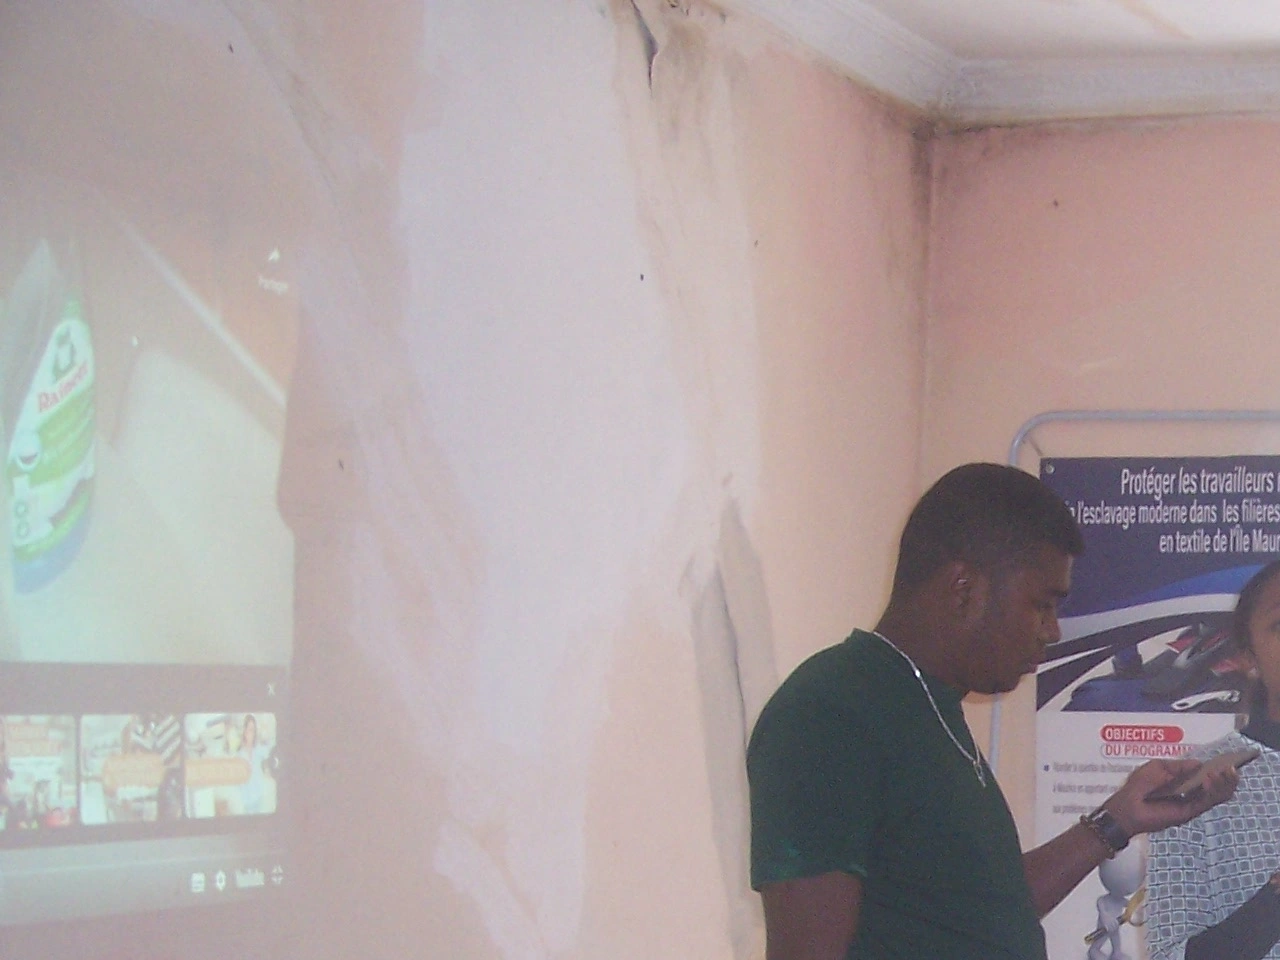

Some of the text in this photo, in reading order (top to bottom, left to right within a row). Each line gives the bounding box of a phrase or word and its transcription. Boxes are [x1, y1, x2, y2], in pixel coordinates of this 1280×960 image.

[1121, 466, 1176, 500] Protéger
[1179, 466, 1198, 495] les
[1201, 465, 1274, 494] travailleurs
[1077, 500, 1136, 530] l'esclavage
[1138, 500, 1187, 525] moderne
[1189, 500, 1217, 525] dans
[1222, 499, 1240, 523] les
[1242, 497, 1280, 523] filières
[1159, 532, 1174, 554] en
[1176, 529, 1211, 553] textile
[1213, 527, 1228, 553] de
[1105, 728, 1165, 742] OBJECTIFS
[1105, 743, 1121, 756] DU
